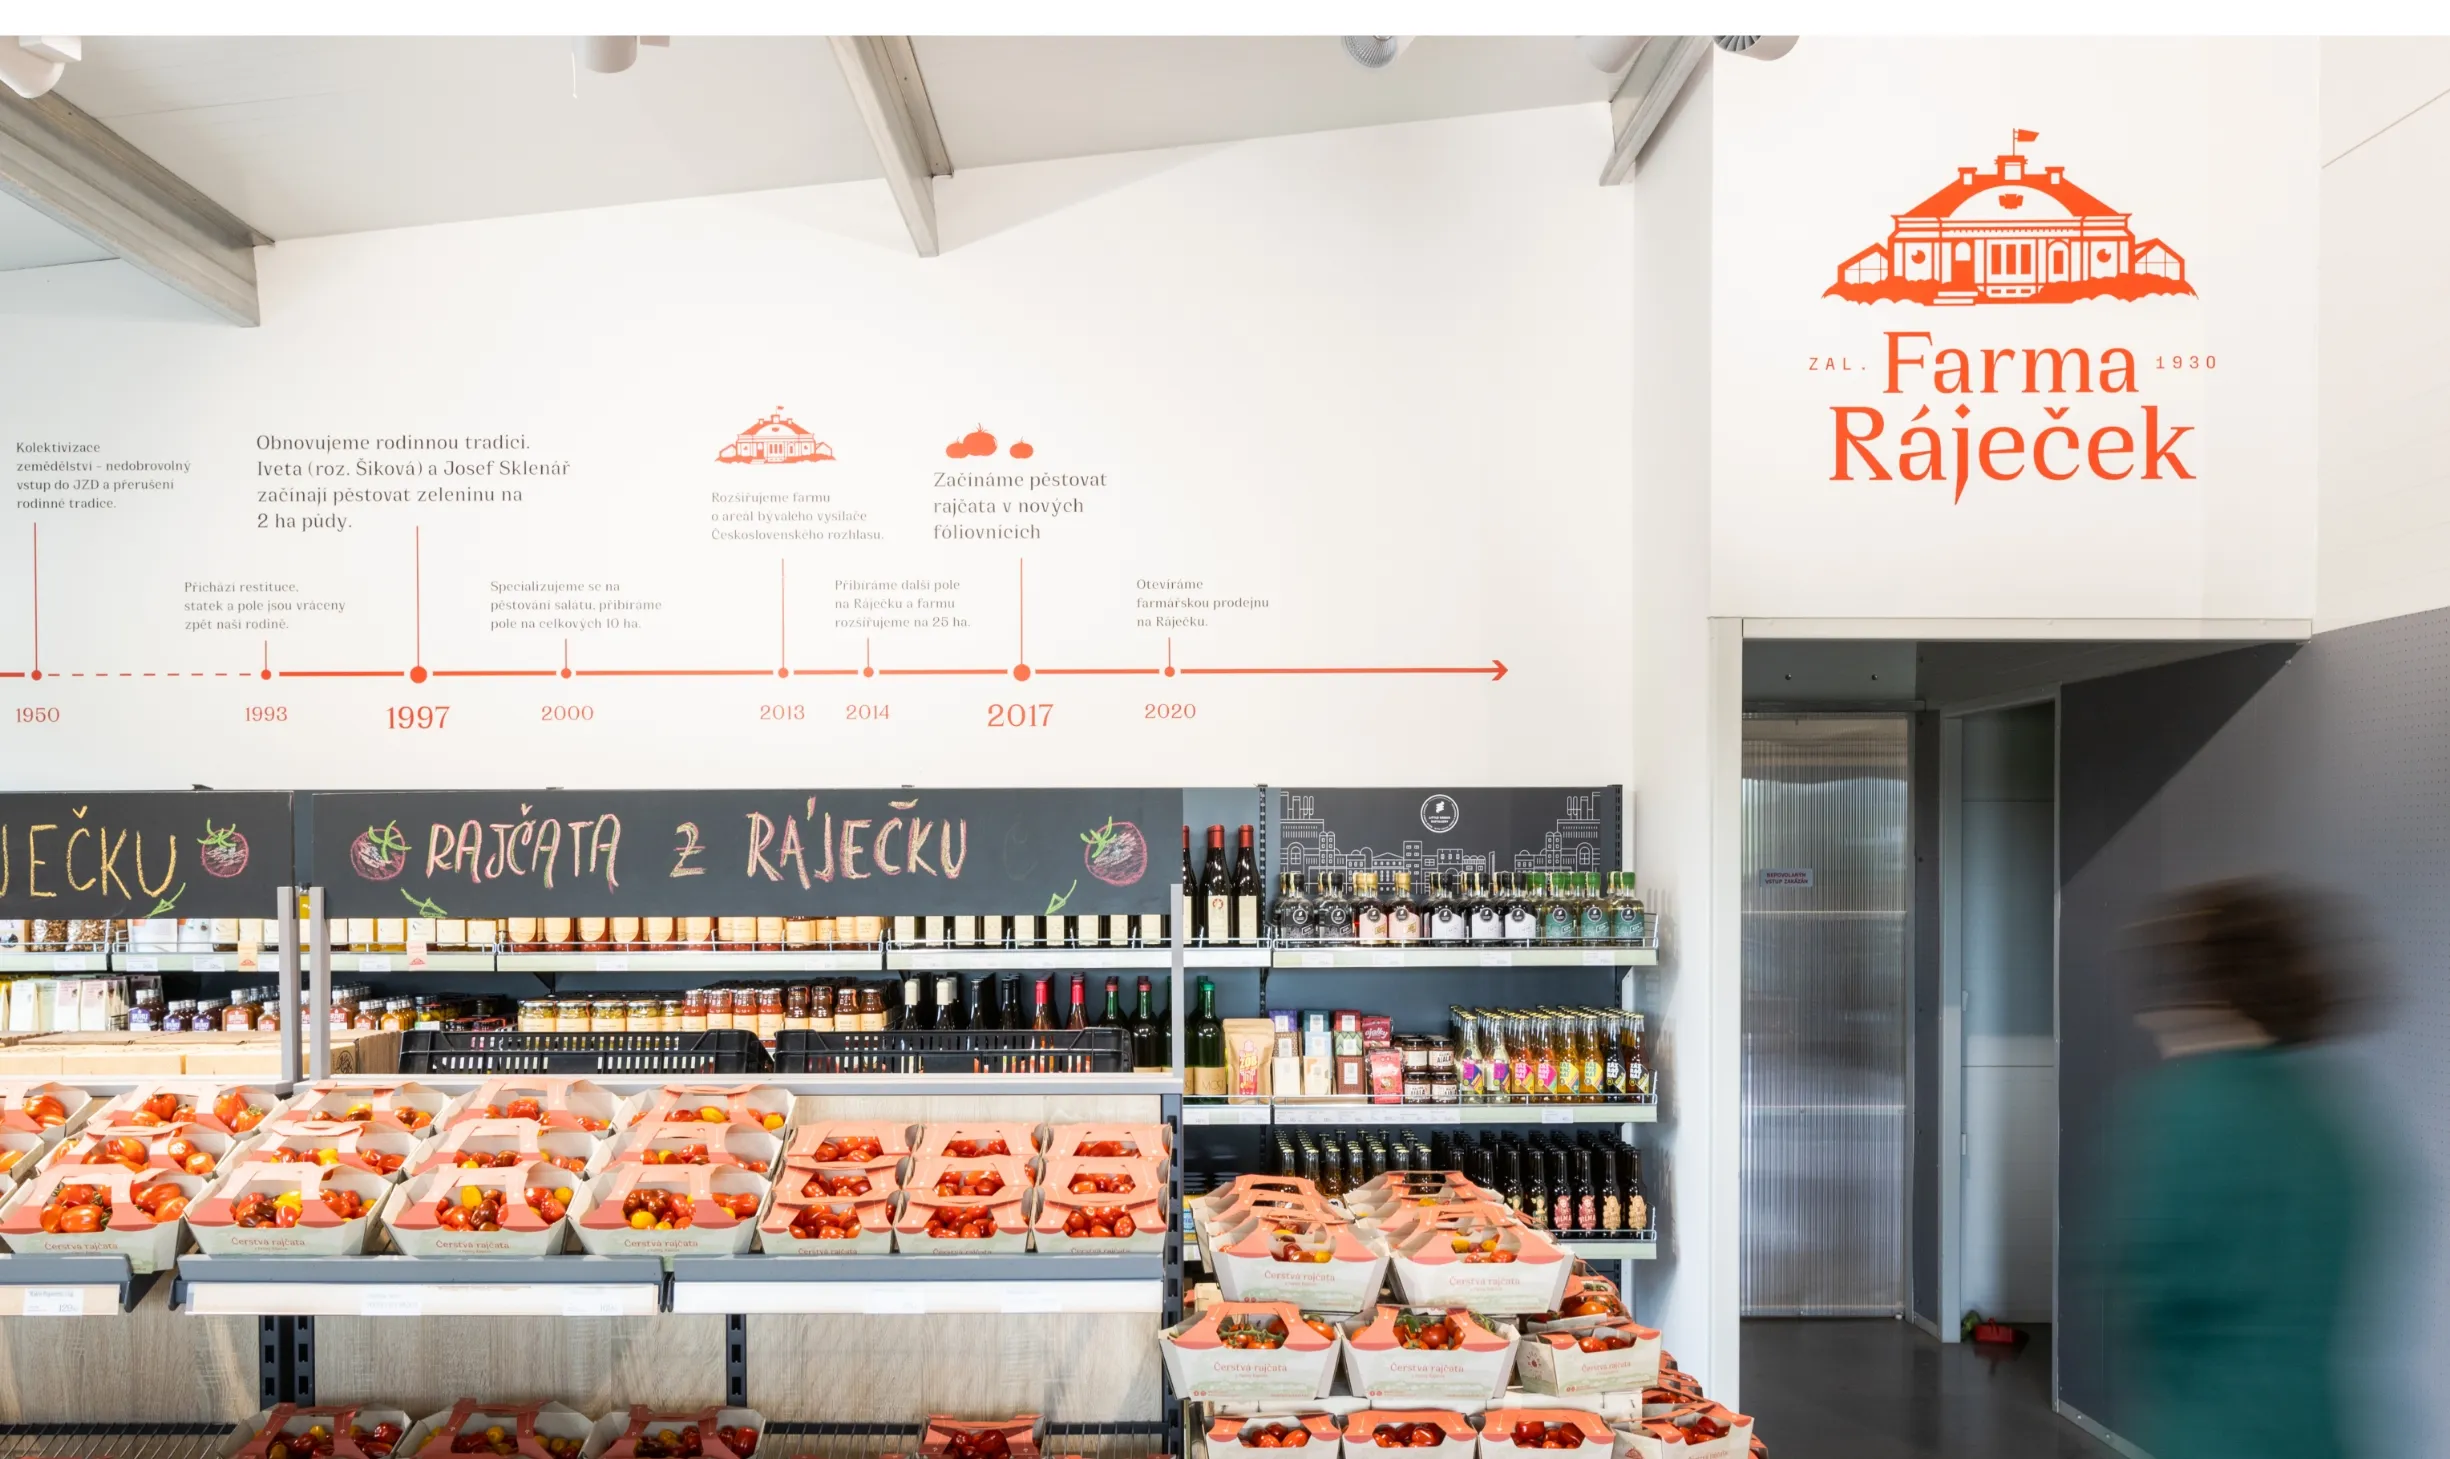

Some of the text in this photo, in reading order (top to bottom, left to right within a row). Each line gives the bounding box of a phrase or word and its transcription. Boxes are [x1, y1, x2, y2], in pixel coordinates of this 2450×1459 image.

[1809, 331, 2217, 394] ZAL. Farma 1930
[16, 442, 101, 453] Kolektivizace
[256, 435, 530, 453] Obnovujeme rodinnou tradici.
[1828, 403, 2197, 505] Ráječek
[16, 461, 93, 471] zemědělství
[105, 461, 191, 473] nedobrovolný
[257, 458, 571, 476] Iveta (roz. Šiková) a Josef Sklenář
[16, 481, 52, 492] vstup
[53, 480, 70, 490] do
[72, 479, 100, 490] JZD
[113, 480, 174, 492] přerušení
[934, 472, 1107, 490] Začínáme pěstovat
[17, 498, 117, 508] rodinné tradice.
[257, 487, 522, 506] začínají pěstovat zeleninu na
[792, 493, 831, 502] farmu
[934, 498, 1084, 517] rajčata v nových
[257, 513, 269, 528] 2
[275, 514, 296, 528] ha
[184, 582, 236, 592] Přichází
[490, 581, 585, 594] Specializujeme
[835, 580, 898, 590] Přibíráme
[934, 580, 961, 592] pole
[1136, 579, 1204, 589] Otevíráme
[184, 601, 223, 611] statek
[237, 601, 264, 613] pole
[267, 600, 292, 612] jsou
[296, 601, 346, 613] vráceny
[599, 600, 662, 612] přibíráme
[853, 598, 903, 610] Ráječku
[917, 598, 955, 608] farmu
[1136, 597, 1269, 610] farmářskou prodejnu
[184, 620, 213, 632] zpět
[245, 619, 289, 629] rodině.
[490, 618, 517, 631] pole
[539, 618, 602, 631] celkových
[623, 619, 641, 628] ha.
[932, 617, 949, 627] 25
[952, 617, 971, 627] ha.
[1156, 616, 1208, 629] Ráječku.
[15, 708, 61, 722] 1950
[245, 707, 288, 721] 1993
[386, 706, 451, 729] 1997
[541, 705, 595, 721] 2000
[759, 705, 806, 720] 2013
[845, 705, 890, 720] 2014
[987, 704, 1055, 727] 2017
[1144, 704, 1197, 719] 2020
[426, 803, 621, 893] RAJČATA
[746, 796, 967, 890] RÁJEČKU
[231, 1236, 306, 1247] Čerstvá rajčata
[436, 1240, 510, 1250] Čerstvá rajčata
[1213, 1361, 1288, 1374] Čerstvá rajčata
[1390, 1362, 1464, 1374] Čerstvá rajčata
